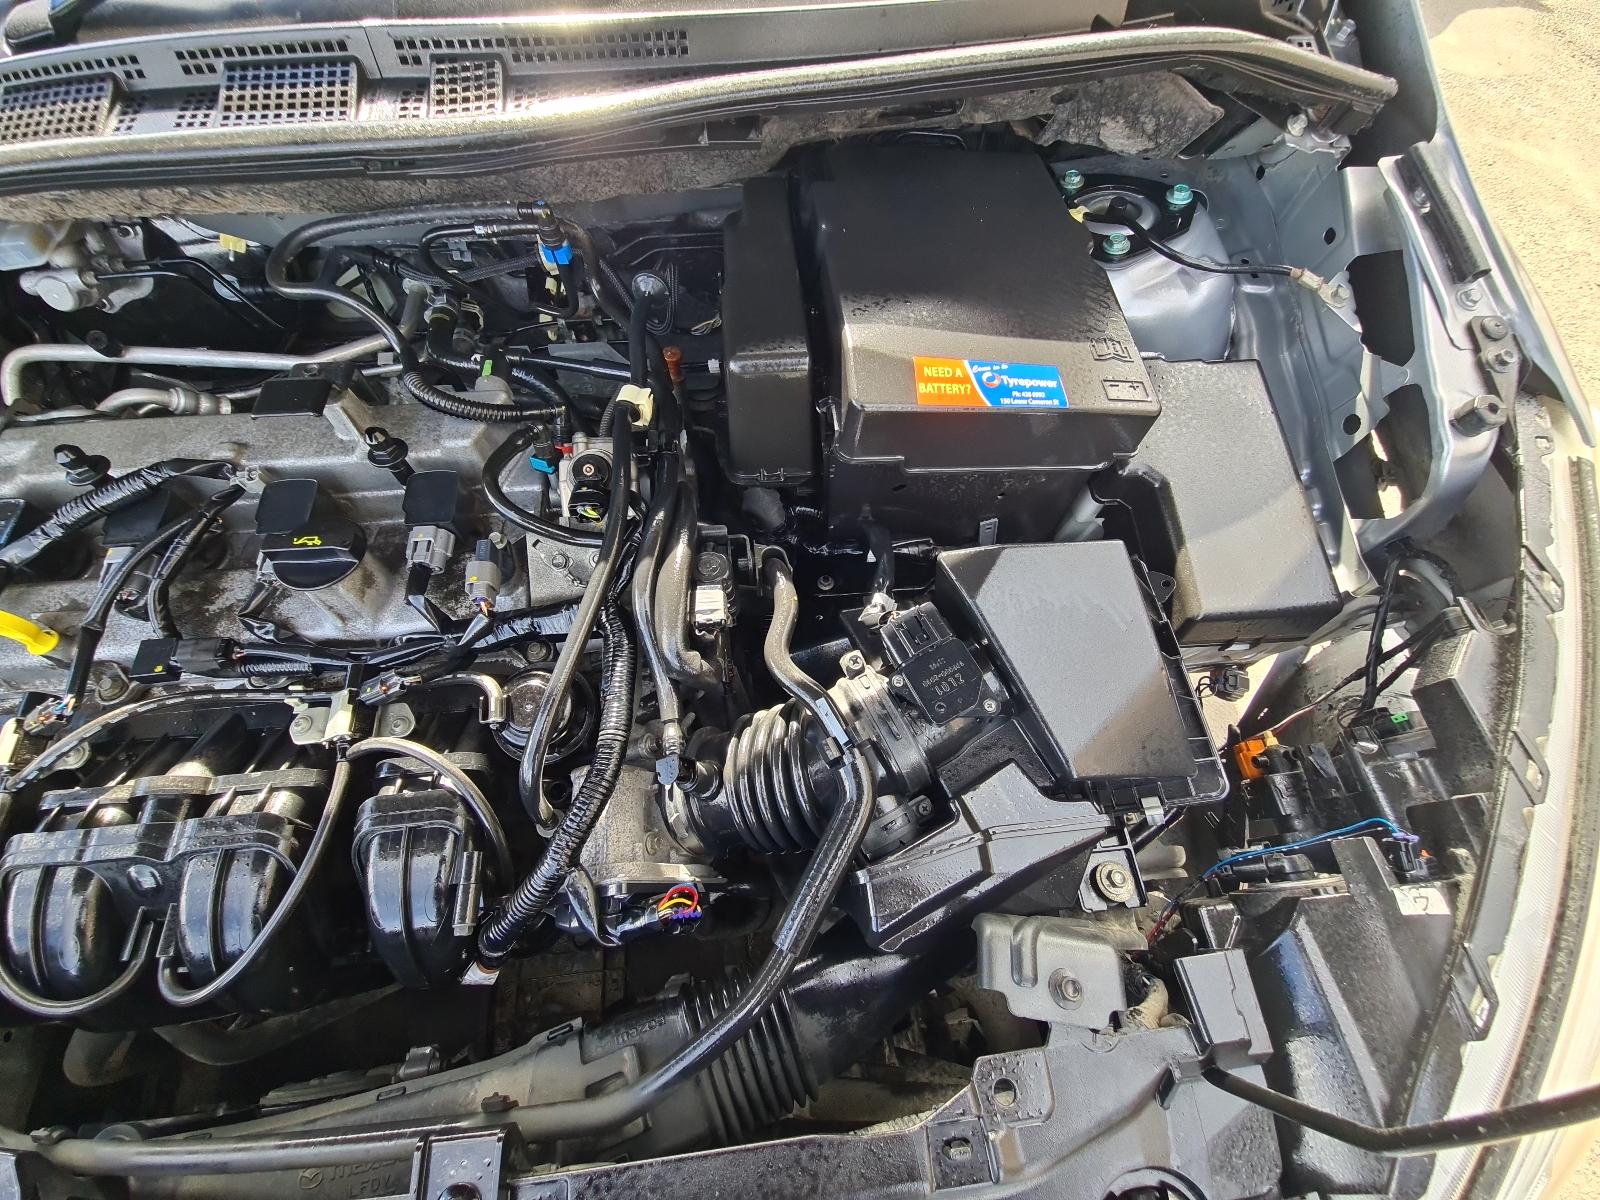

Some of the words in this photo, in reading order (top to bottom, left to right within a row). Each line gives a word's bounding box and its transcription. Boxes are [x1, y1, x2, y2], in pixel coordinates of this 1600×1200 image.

[923, 366, 952, 378] NEED
[953, 368, 964, 378] A
[1000, 375, 1058, 389] Tyrepower
[918, 382, 971, 396] BATTERY?
[1028, 398, 1052, 406] Cameron
